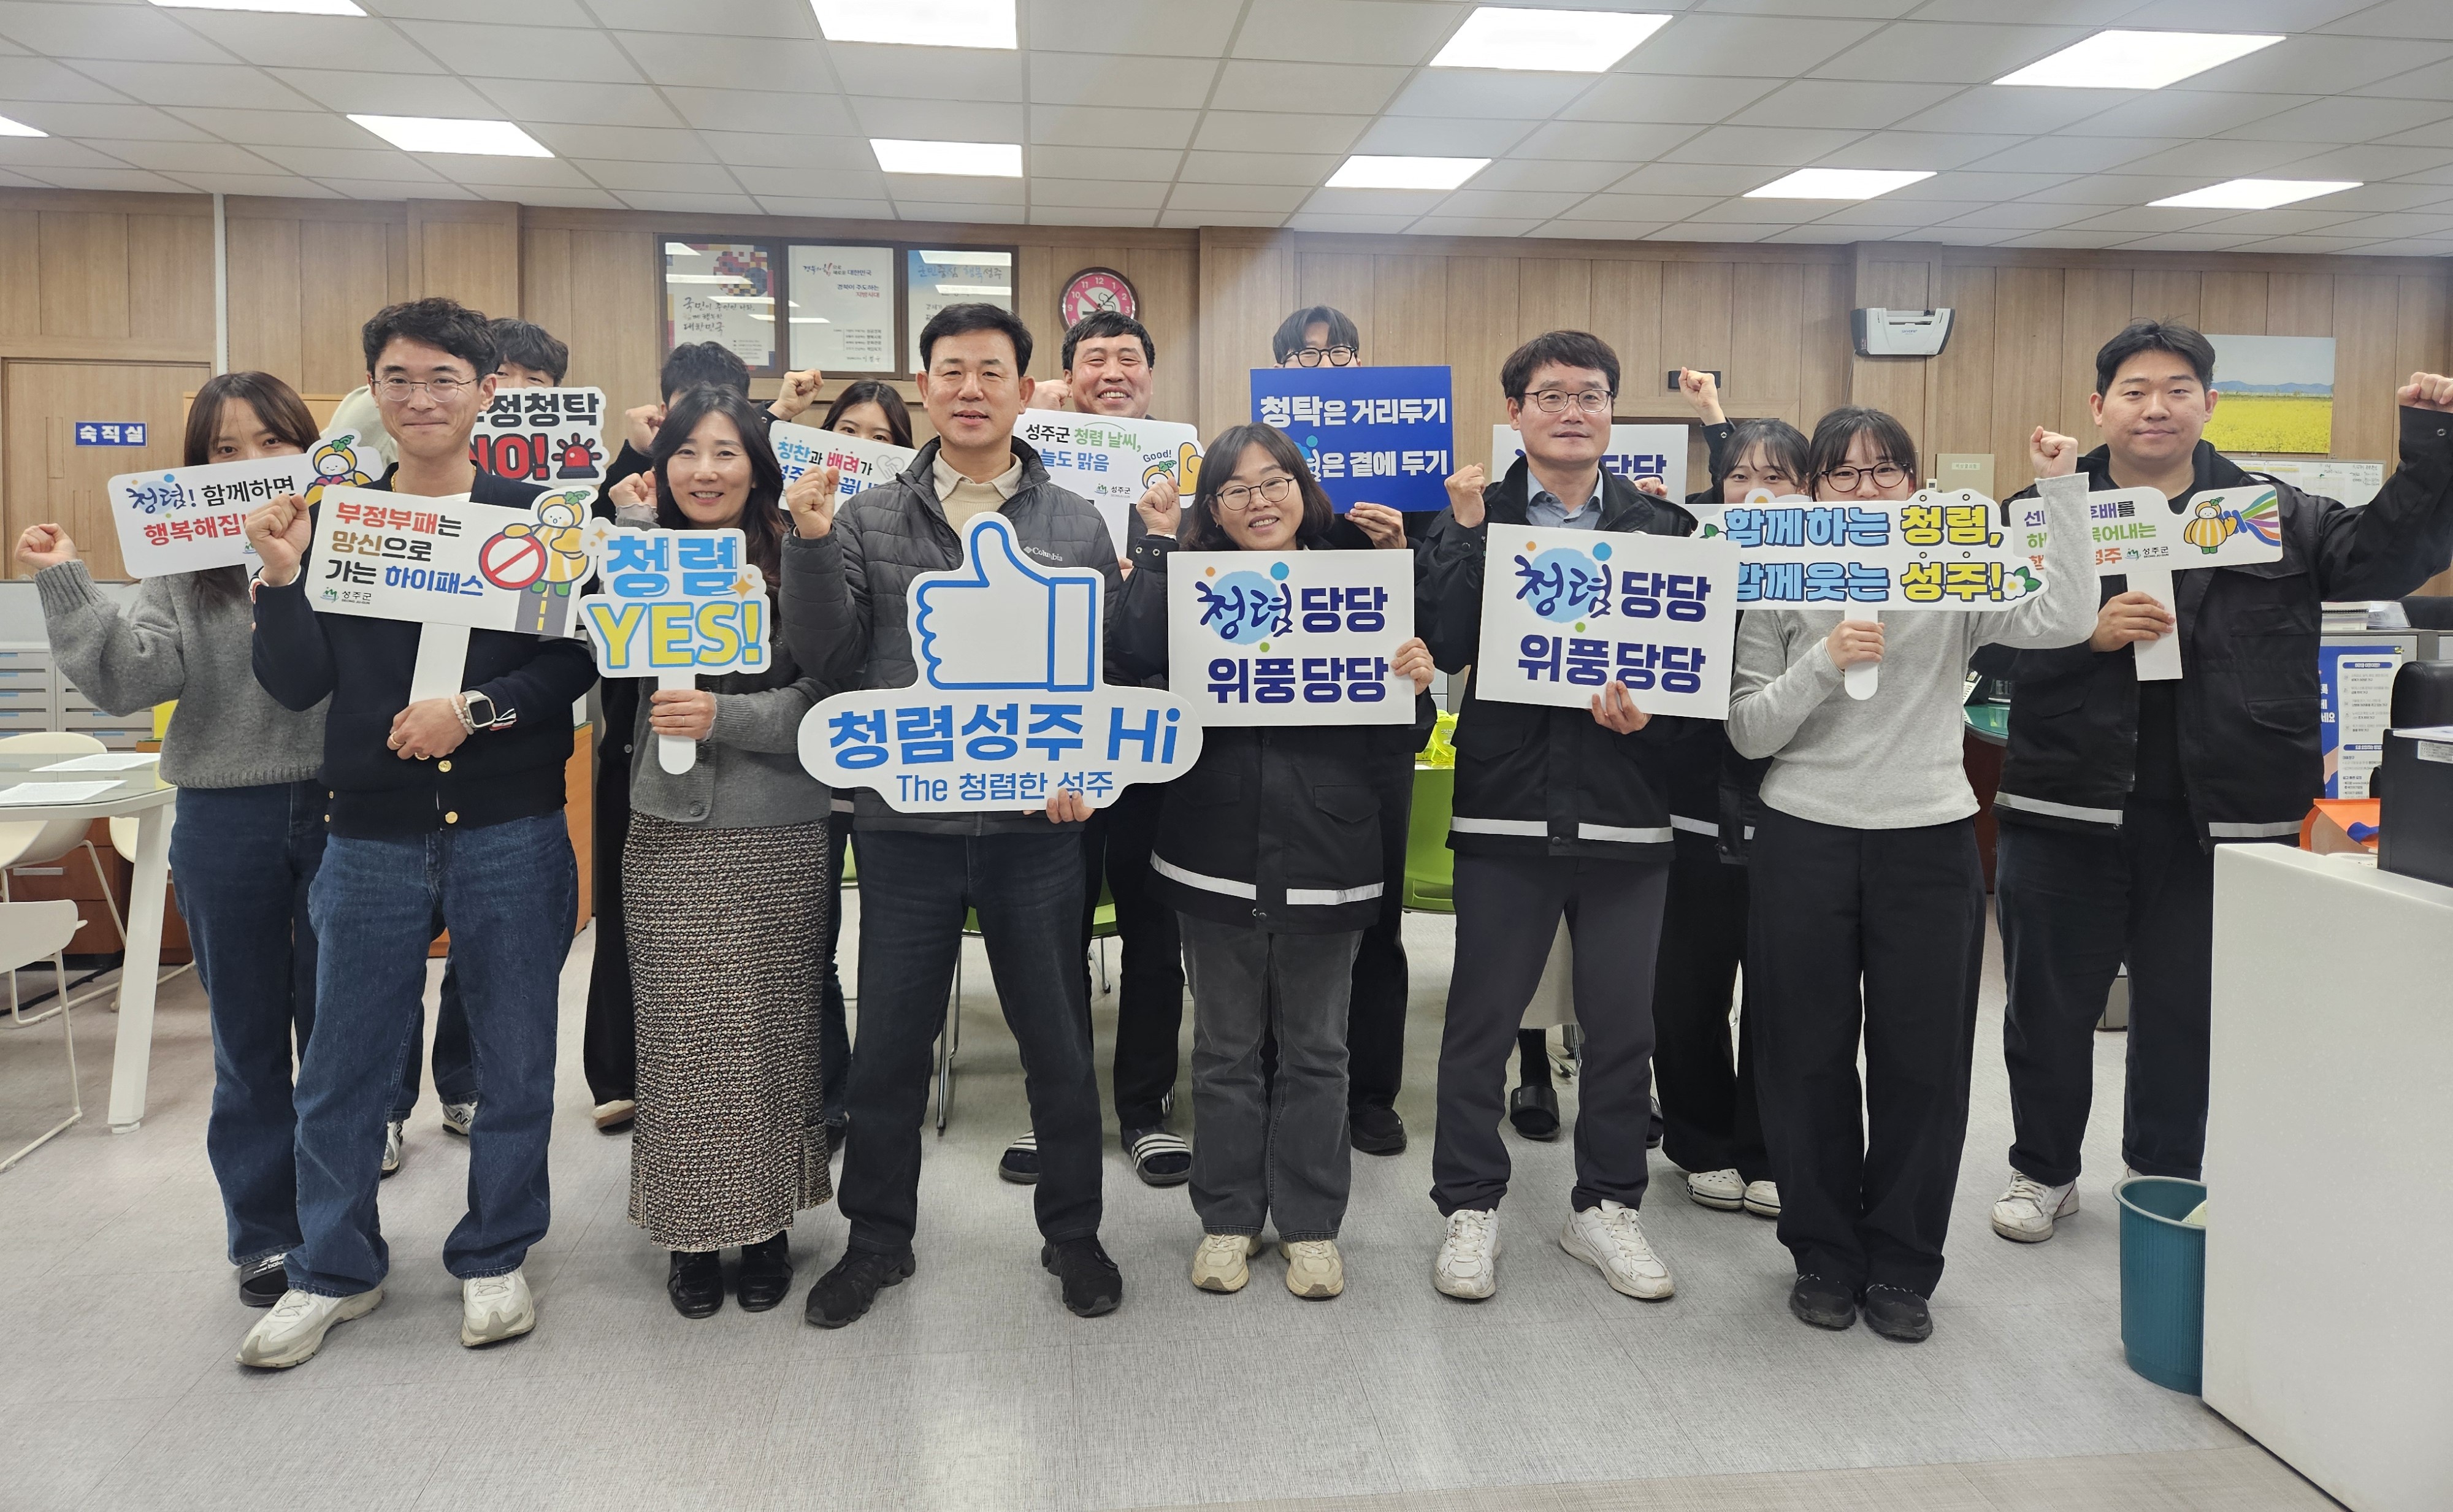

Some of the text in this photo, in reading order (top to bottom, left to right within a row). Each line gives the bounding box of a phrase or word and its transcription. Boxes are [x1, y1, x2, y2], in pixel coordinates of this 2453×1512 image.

[684, 322, 724, 336] 대한민국
[475, 393, 599, 427] 정청탁
[1260, 396, 1446, 428] 청탁은 거리두기
[80, 426, 144, 443] 숙직실
[1026, 424, 1141, 452] 성주군 청렴 날씨,
[778, 440, 873, 476] 칭찬과 배려가
[1038, 448, 1109, 472] 늘도 맑음
[1143, 449, 1171, 462] Good!
[1350, 451, 1396, 478] 곁에
[1402, 450, 1447, 476] 두기
[126, 475, 296, 515] 청렴! 함께하면
[144, 513, 246, 546] 행복해집
[336, 502, 462, 538] 부정부패는
[1724, 504, 2004, 548] 함께하는 청렴,
[332, 531, 432, 562] 망신으로
[1032, 547, 1063, 562] Columbia
[2143, 546, 2168, 555] 성주군
[326, 559, 484, 597] 가는 하이패스
[607, 536, 738, 598] 청렴
[1736, 560, 2006, 601] 함께웃는 성주!
[342, 590, 372, 601] 성주군
[1514, 554, 1711, 622] 청렴 당당
[1195, 581, 1388, 640] 청렴 당당
[587, 600, 762, 670] YES!
[1207, 657, 1388, 703] 위풍당당
[1518, 634, 1706, 693] 위풍당당
[829, 703, 1181, 770] 청렴성주 Hi
[896, 771, 1113, 802] The 청렴한 성주
